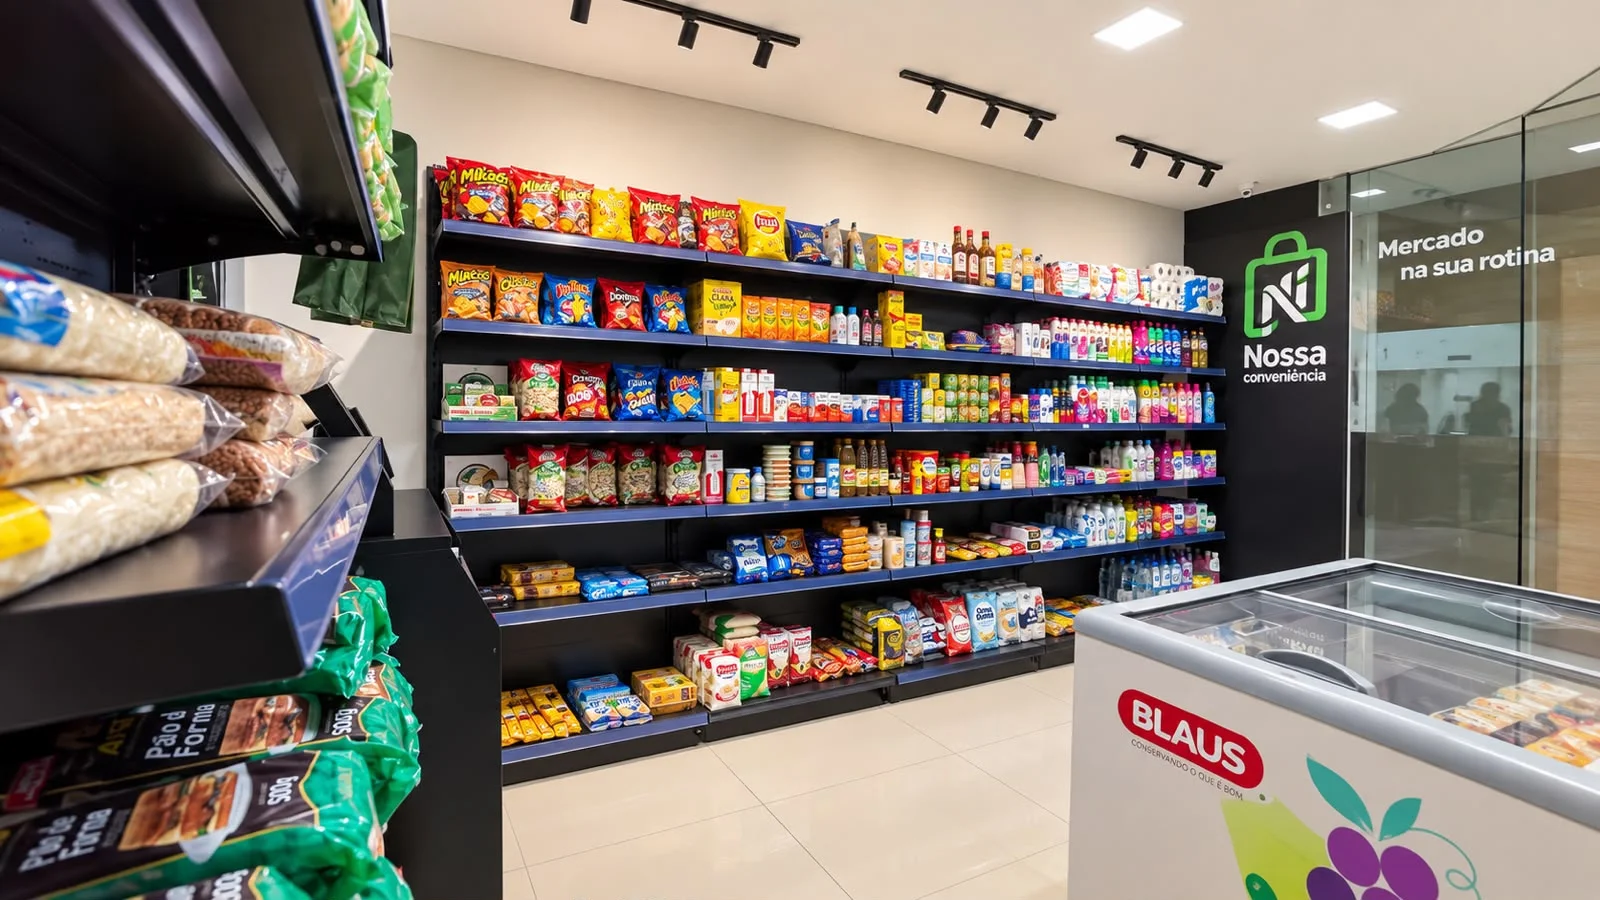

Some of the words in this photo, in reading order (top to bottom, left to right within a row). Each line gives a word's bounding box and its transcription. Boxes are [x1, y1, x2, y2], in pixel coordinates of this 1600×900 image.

[1378, 227, 1484, 259] Mercado
[1400, 264, 1428, 280] na
[1432, 257, 1474, 276] sua
[1479, 246, 1555, 271] rotina
[1243, 344, 1327, 368] Nossa
[1243, 368, 1327, 383] conveniência
[1133, 699, 1245, 775] BLAUS
[1131, 738, 1189, 772] CONSERVANDO
[1189, 767, 1197, 776] O
[1198, 772, 1215, 785] QUE
[1224, 784, 1243, 801] BOM
[267, 776, 299, 806] 500g
